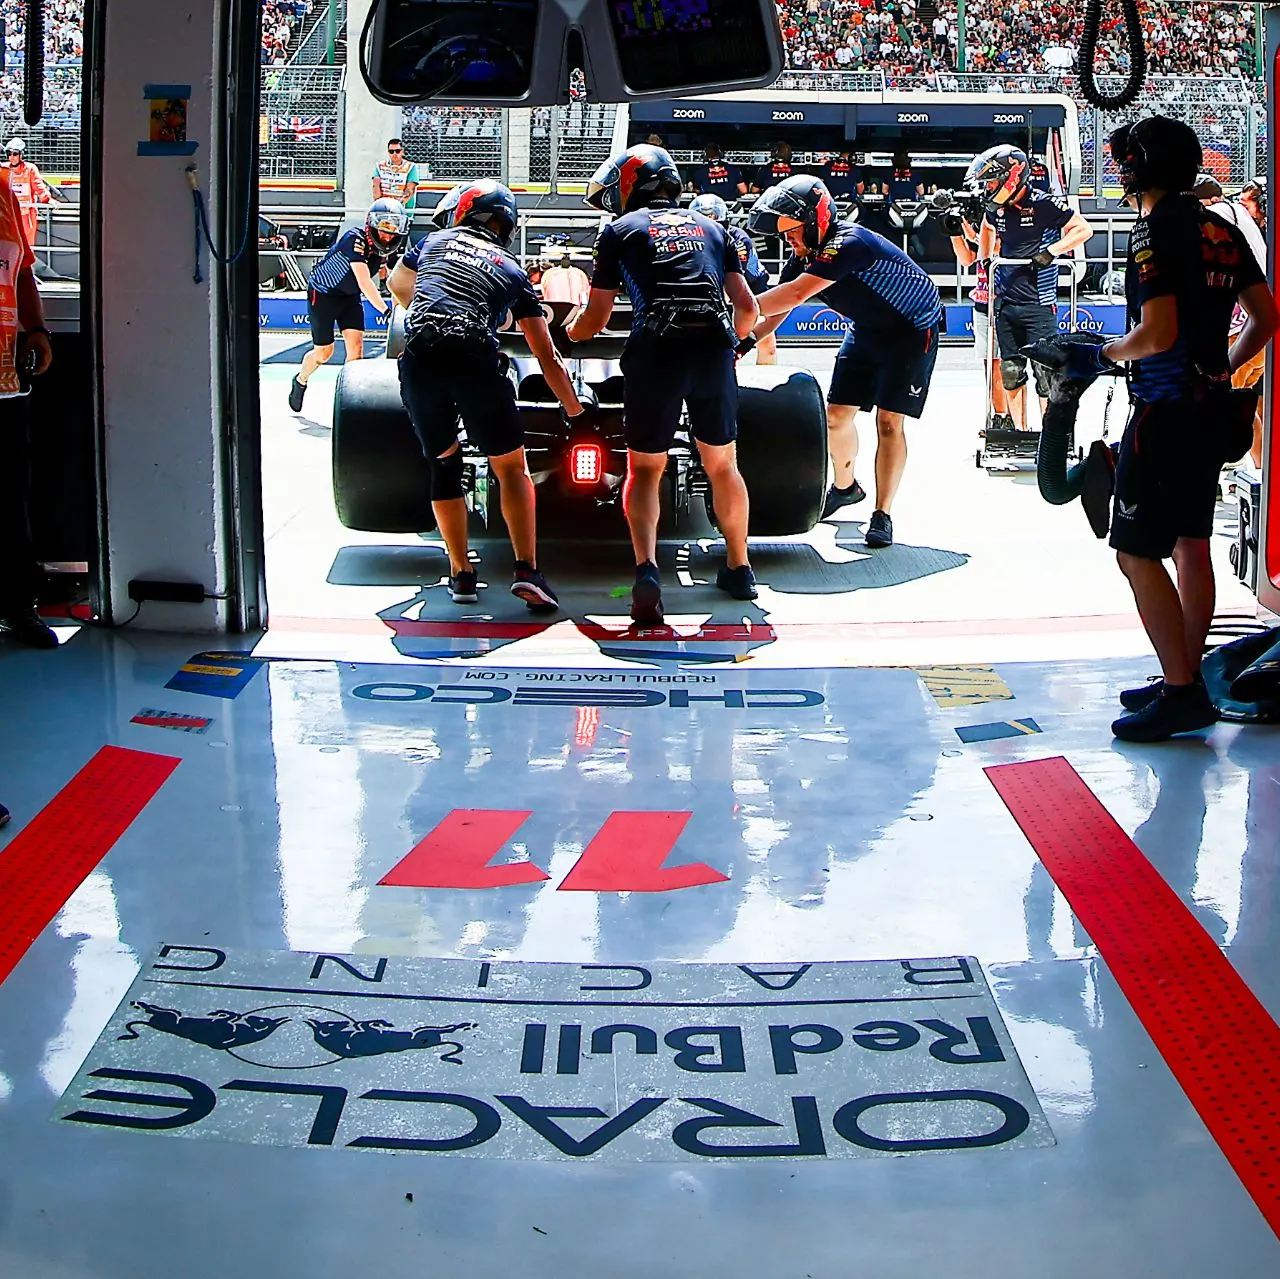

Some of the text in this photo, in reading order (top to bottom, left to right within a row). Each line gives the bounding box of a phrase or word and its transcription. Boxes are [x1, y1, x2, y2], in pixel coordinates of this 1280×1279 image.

[673, 108, 705, 119] zoom
[772, 111, 804, 120] zoom
[897, 112, 929, 123] zoom
[993, 113, 1024, 124] zoom
[352, 684, 826, 708] CHECO
[376, 808, 732, 892] 11
[152, 945, 974, 991] RACING
[61, 1068, 1029, 1157] ORACLE
